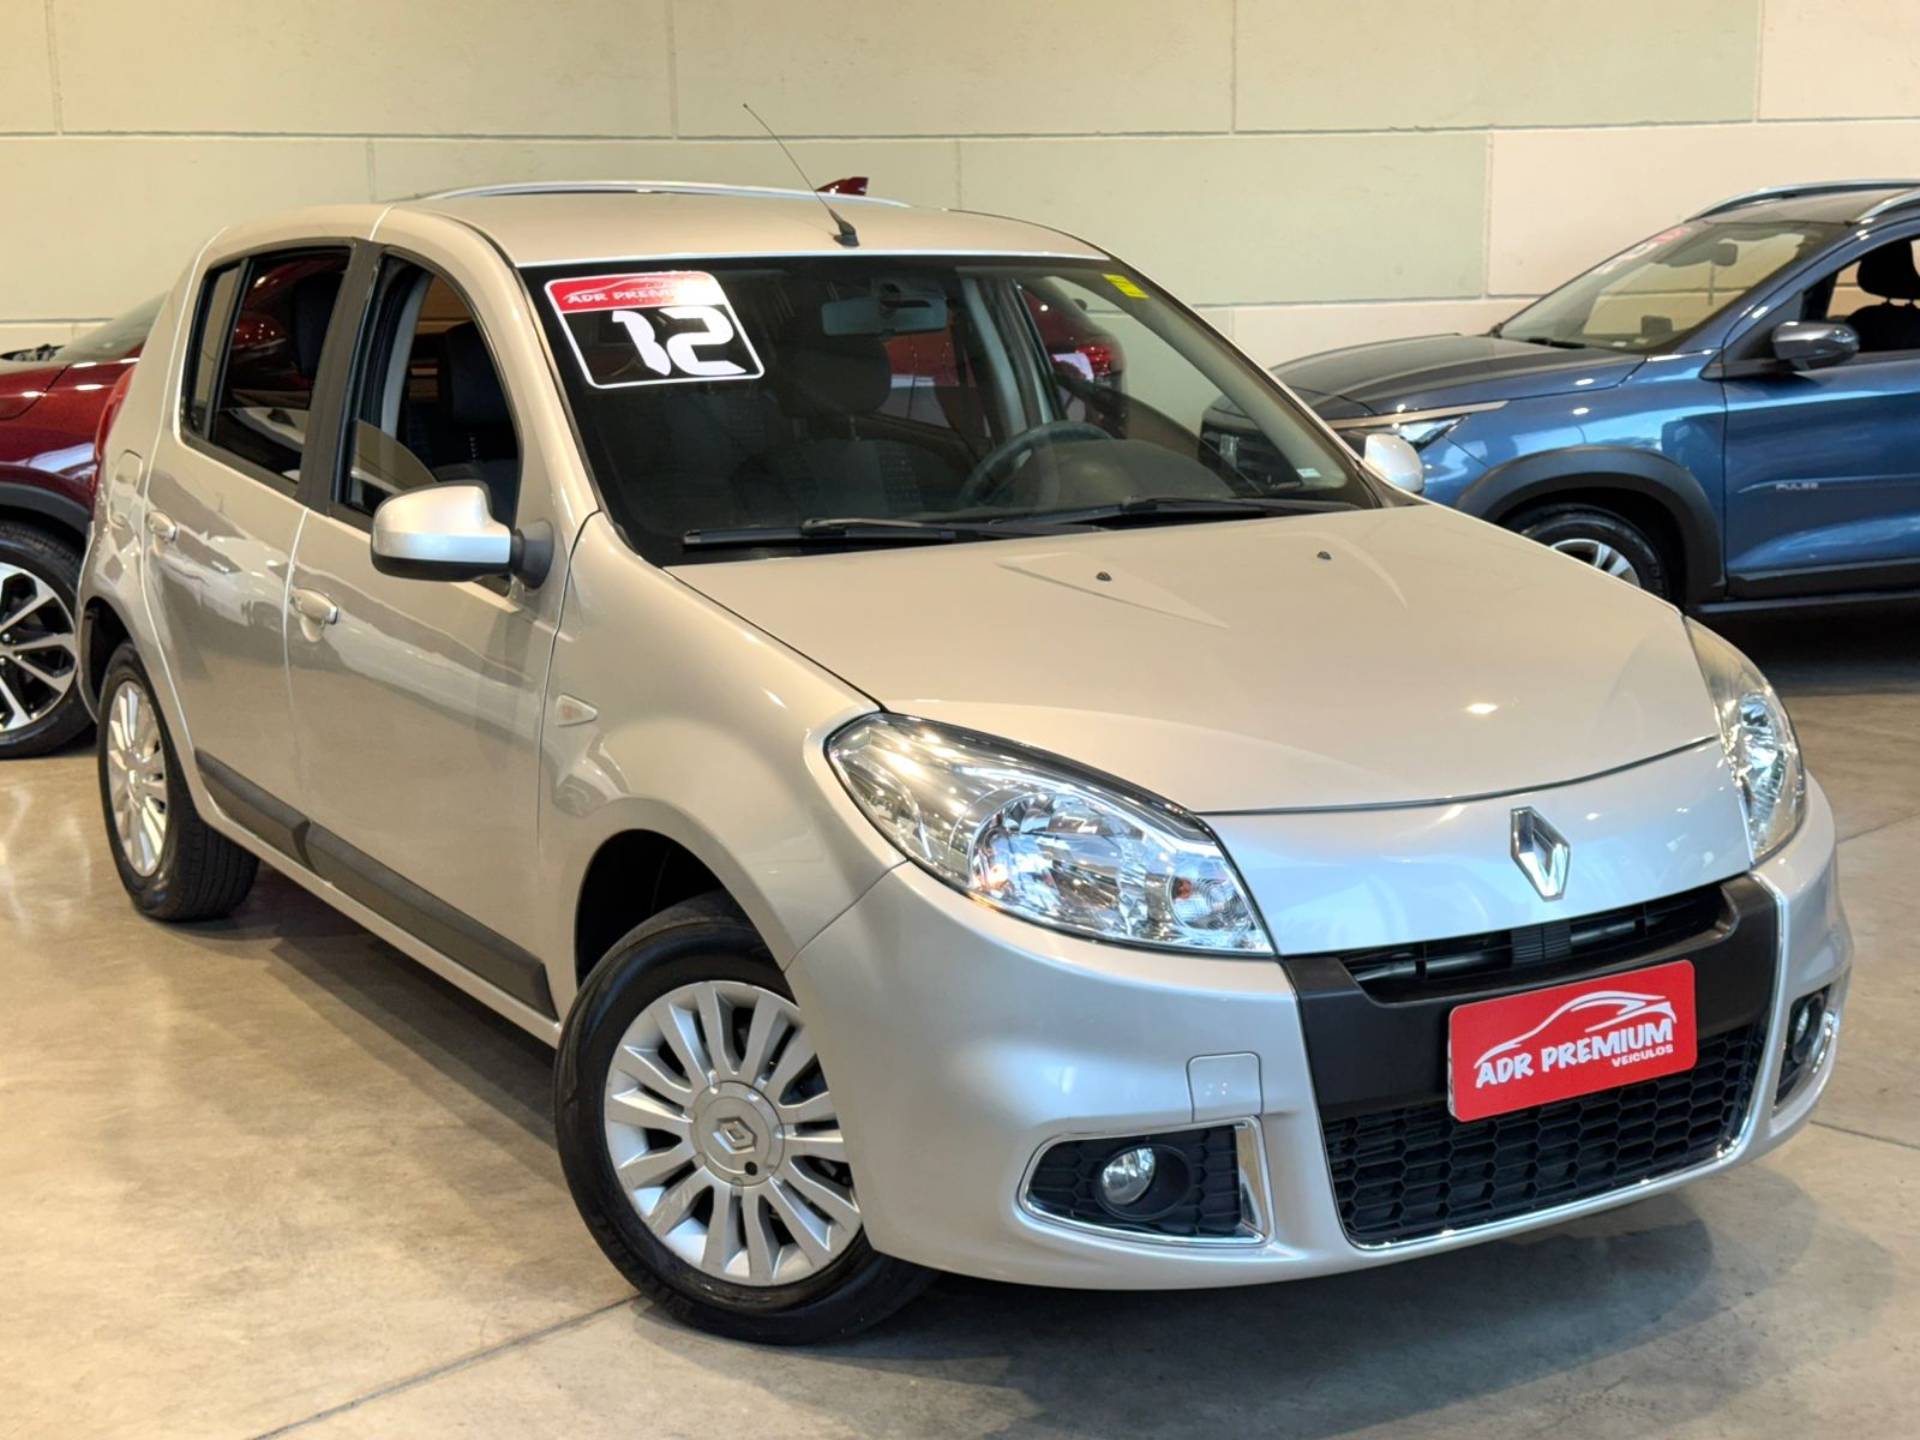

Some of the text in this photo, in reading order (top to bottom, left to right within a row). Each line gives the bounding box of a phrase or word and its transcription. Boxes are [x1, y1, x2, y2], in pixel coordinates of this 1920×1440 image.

[567, 292, 608, 303] ADR
[611, 305, 747, 377] 12
[1475, 1018, 1674, 1089] ADR PREMIUM
[1611, 1043, 1674, 1068] VEICULOS
